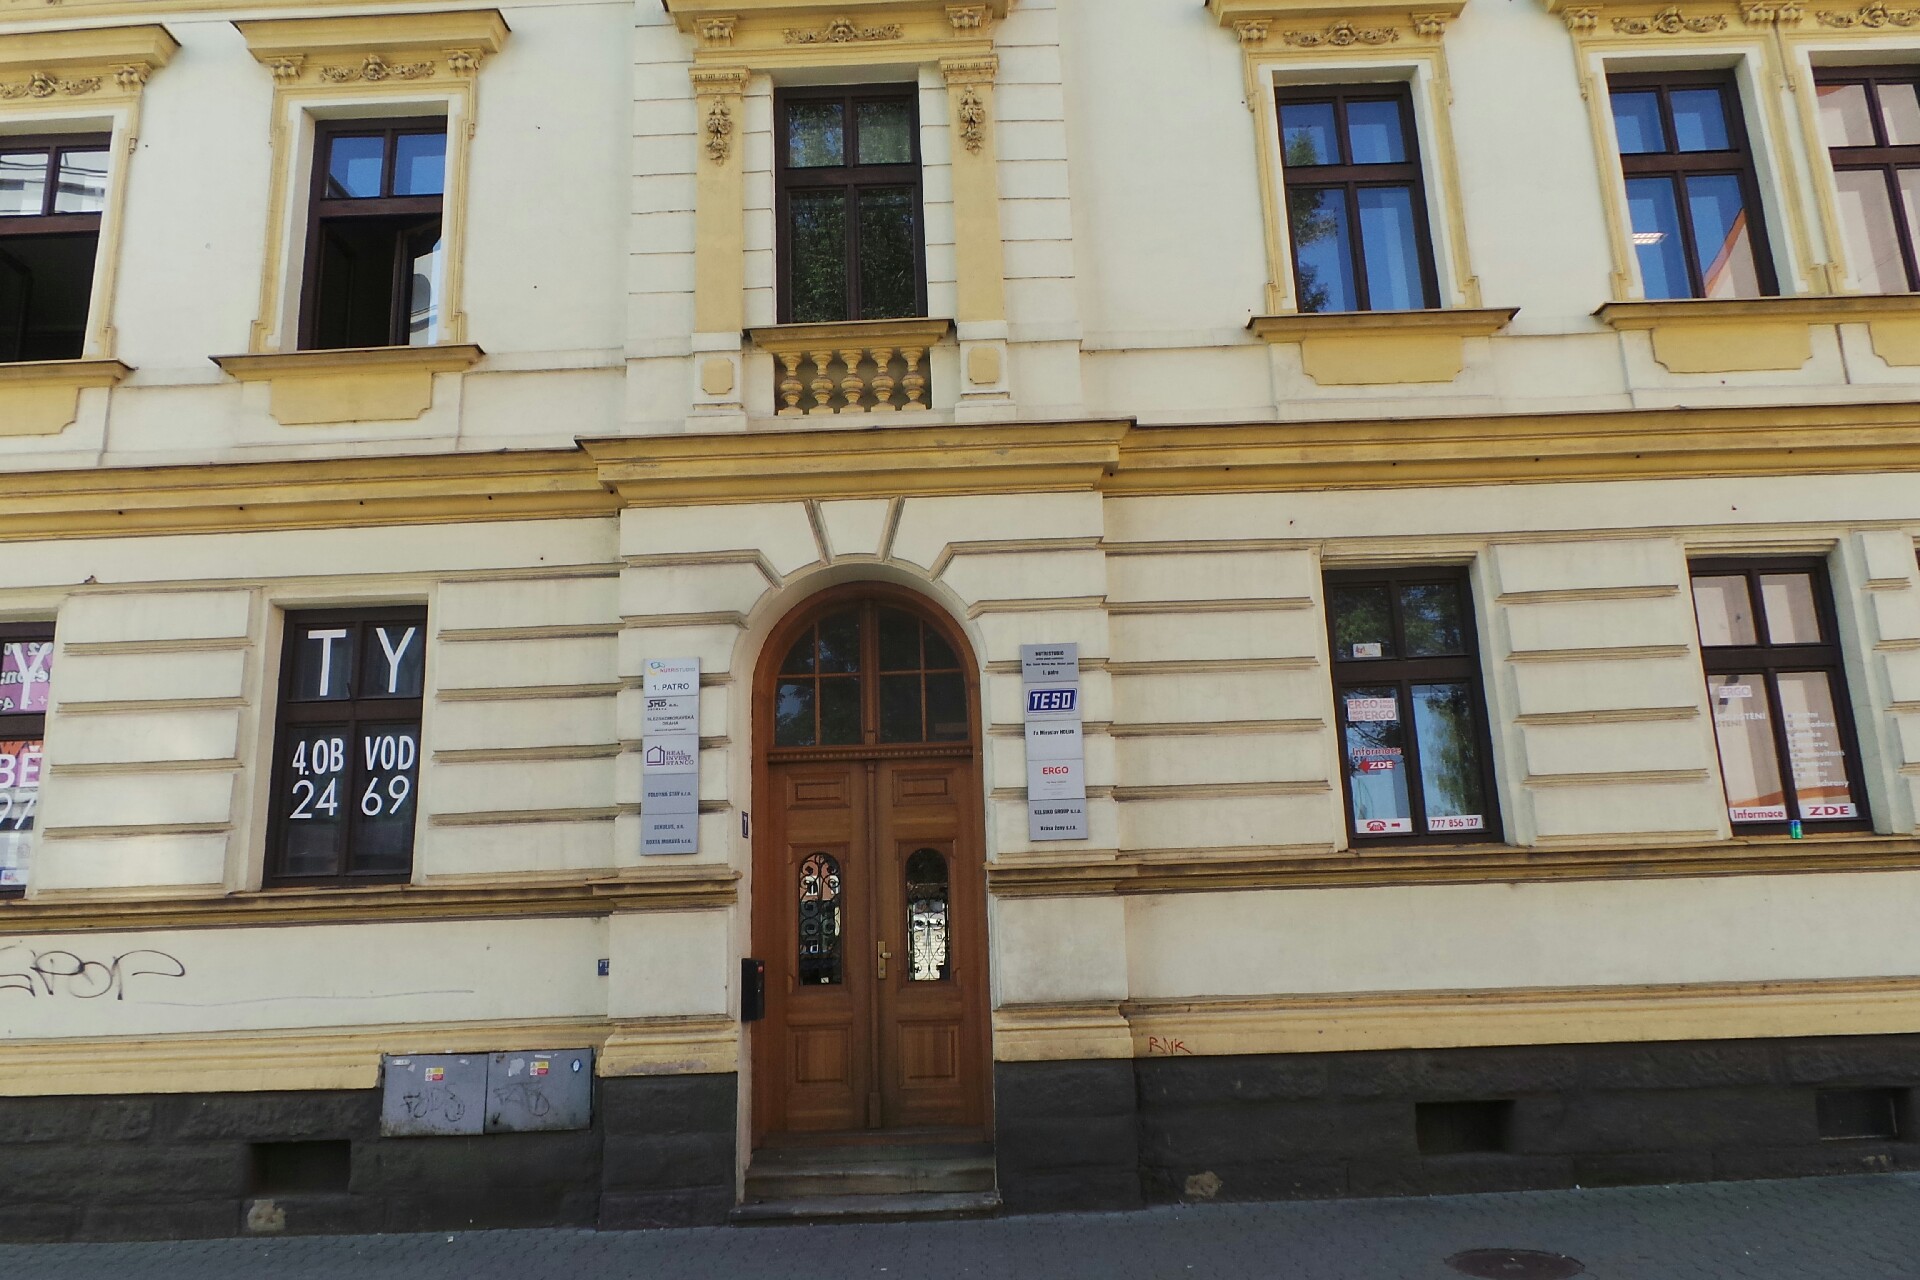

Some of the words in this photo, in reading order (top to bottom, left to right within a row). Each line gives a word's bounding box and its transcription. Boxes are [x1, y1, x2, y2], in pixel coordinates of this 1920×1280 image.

[661, 682, 690, 691] PATRO
[1719, 687, 1750, 697] ERGO
[1032, 692, 1072, 709] TESO
[1348, 699, 1378, 710] ERGO
[1364, 709, 1395, 720] ERGO
[1042, 766, 1069, 775] ERGO
[1368, 761, 1394, 769] ZDE
[289, 777, 338, 819] 24
[361, 775, 410, 816] 69
[1733, 809, 1784, 820] Informace
[1808, 805, 1850, 816] ZDE
[1430, 819, 1446, 828] 777
[1449, 818, 1464, 827] 856
[1466, 817, 1479, 827] 127
